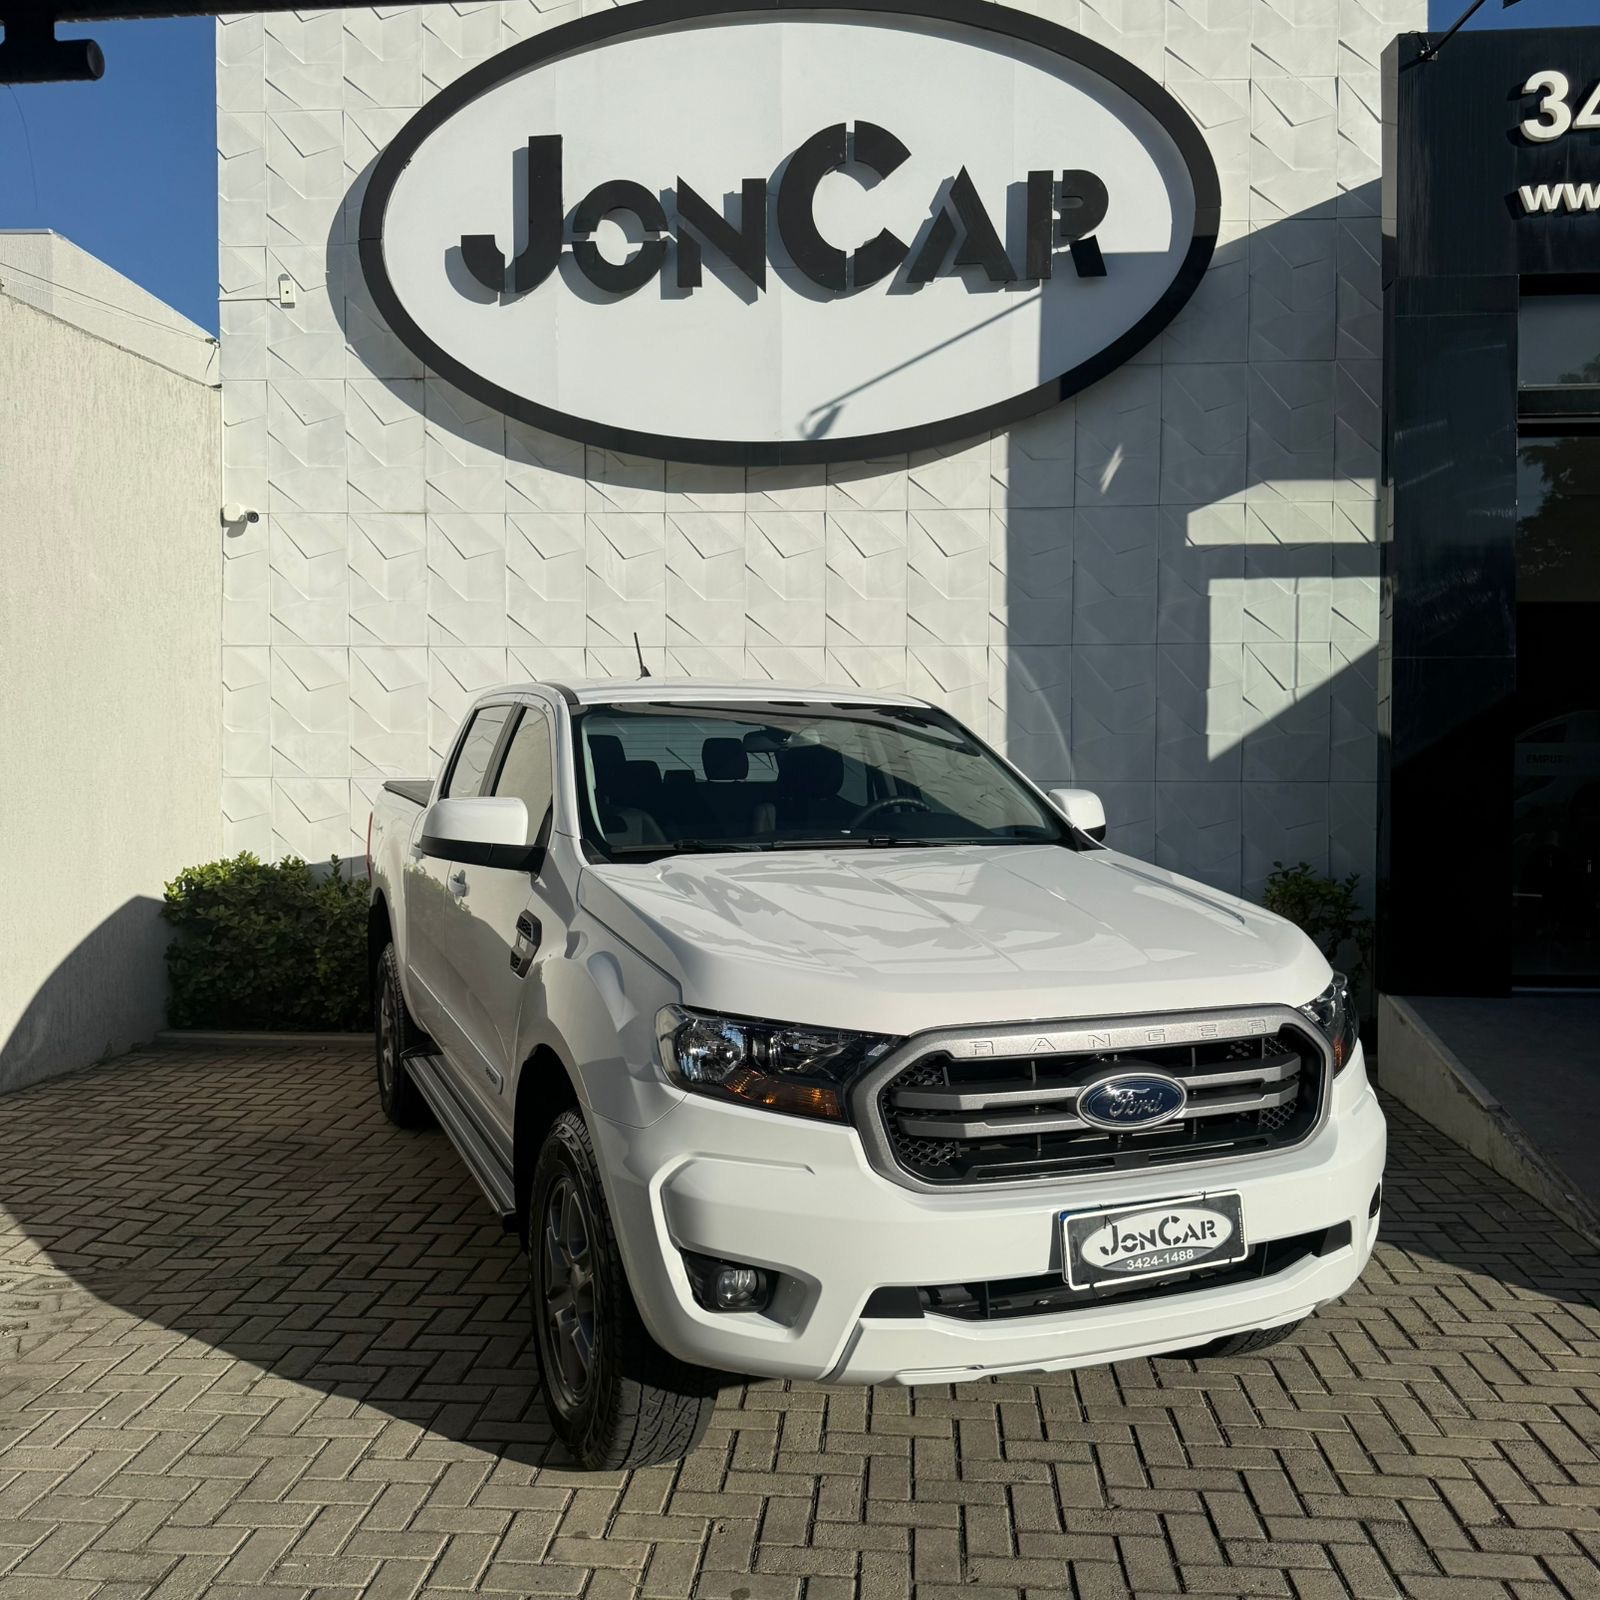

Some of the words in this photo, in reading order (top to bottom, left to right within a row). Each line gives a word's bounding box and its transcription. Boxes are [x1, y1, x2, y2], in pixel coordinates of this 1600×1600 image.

[969, 1019, 1267, 1056] RANGER
[1109, 1087, 1163, 1117] Ford
[1127, 1249, 1194, 1270] 3424-1488
